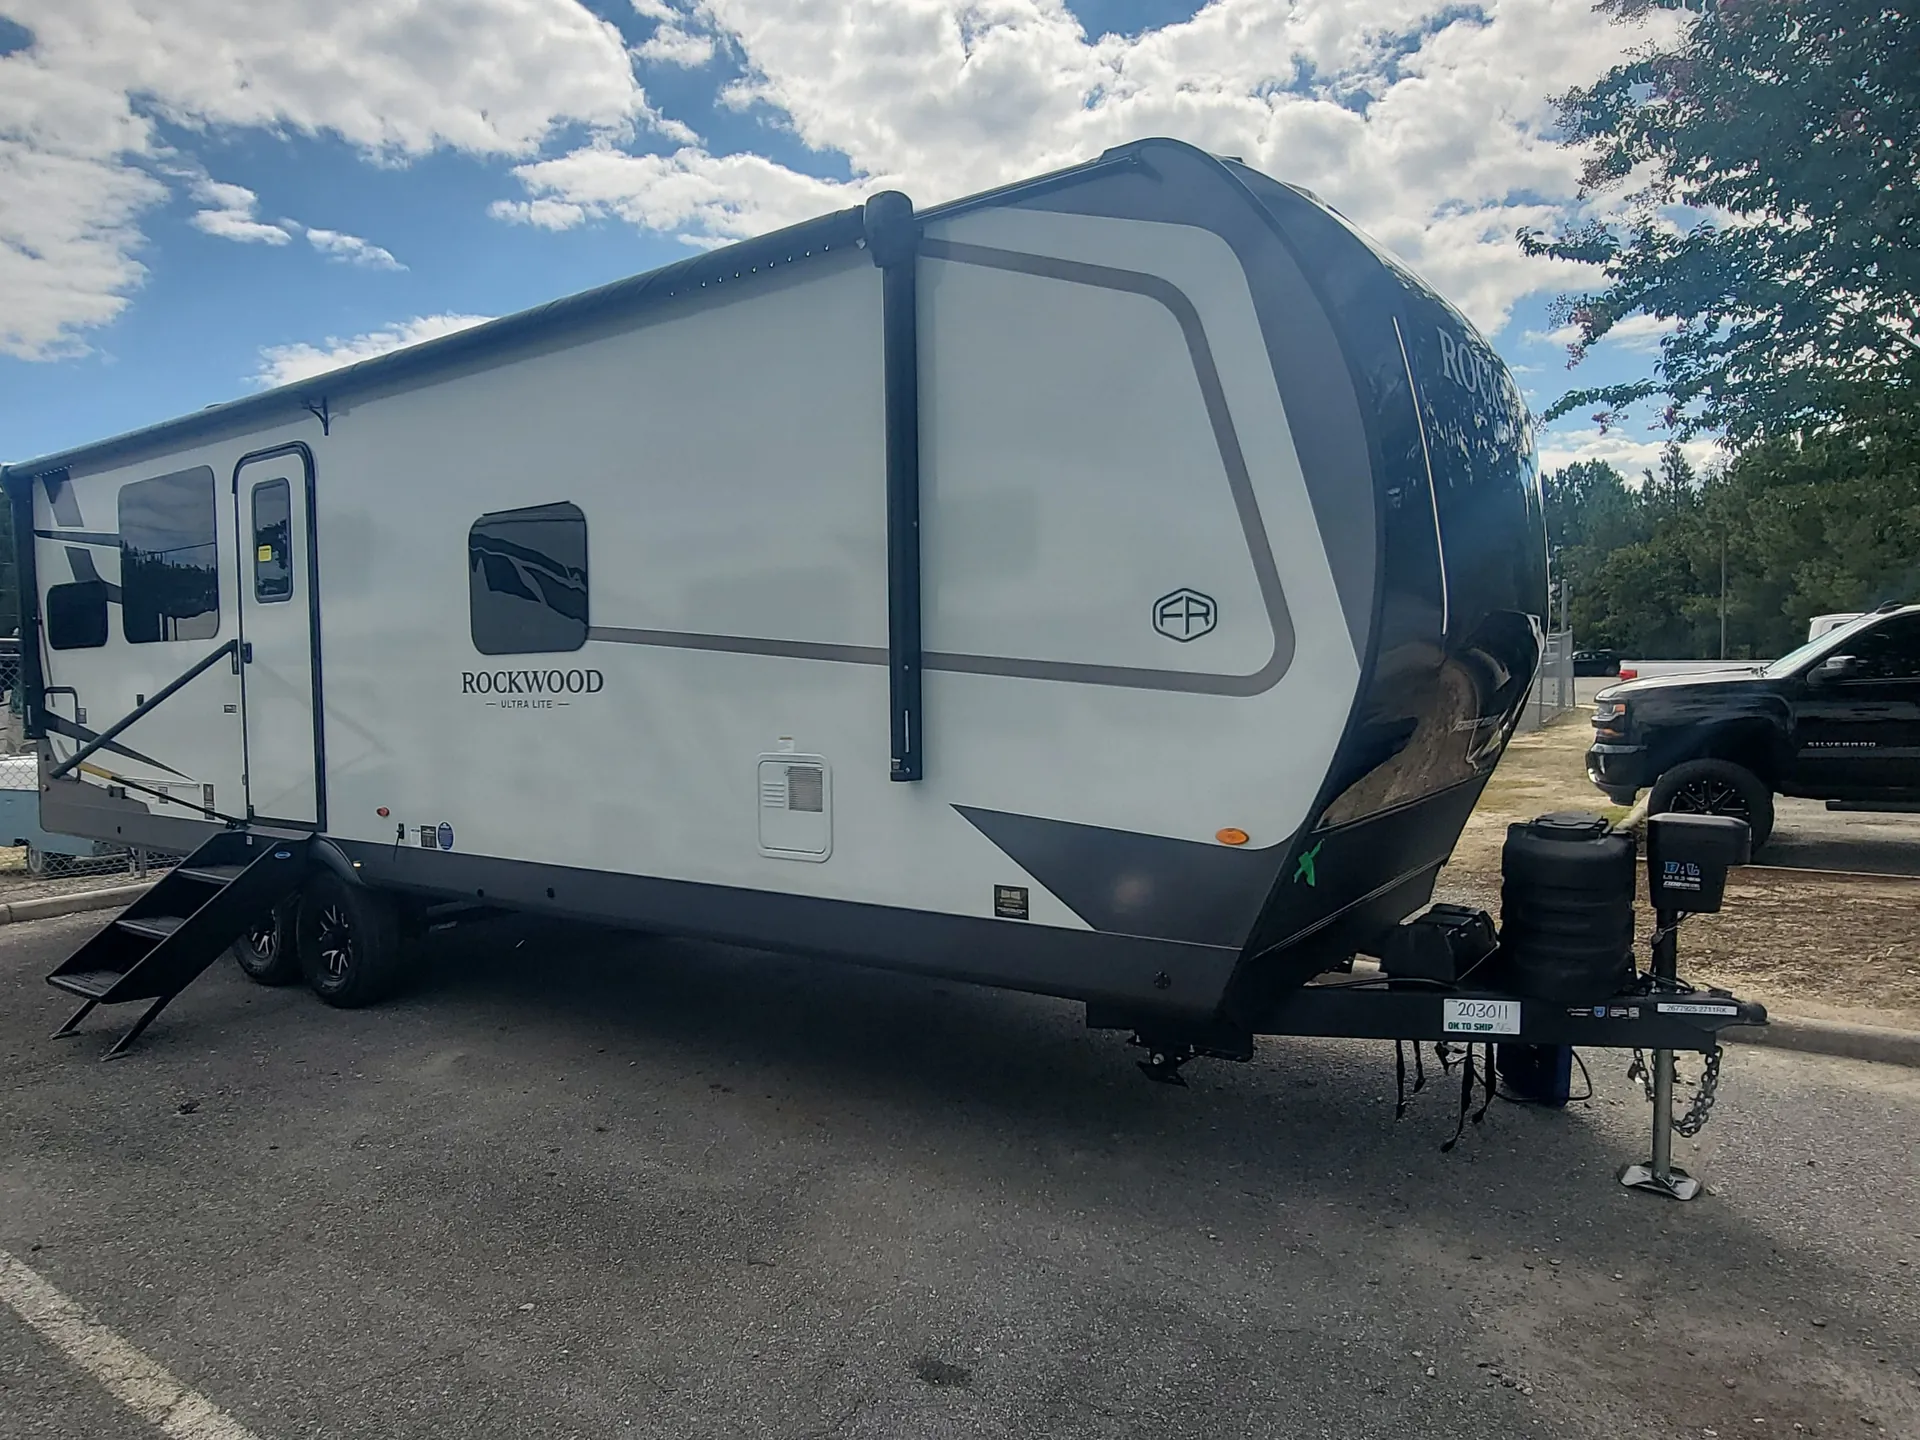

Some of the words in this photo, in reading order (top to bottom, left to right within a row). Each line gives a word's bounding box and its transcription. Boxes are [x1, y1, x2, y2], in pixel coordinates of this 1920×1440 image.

[461, 669, 604, 694] ROCKWOOD
[501, 700, 529, 709] ULTRA
[532, 700, 552, 709] LITE
[1458, 1002, 1508, 1020] 203011
[1448, 1021, 1460, 1030] OK
[1461, 1022, 1472, 1030] TO
[1473, 1023, 1494, 1031] SHIP
